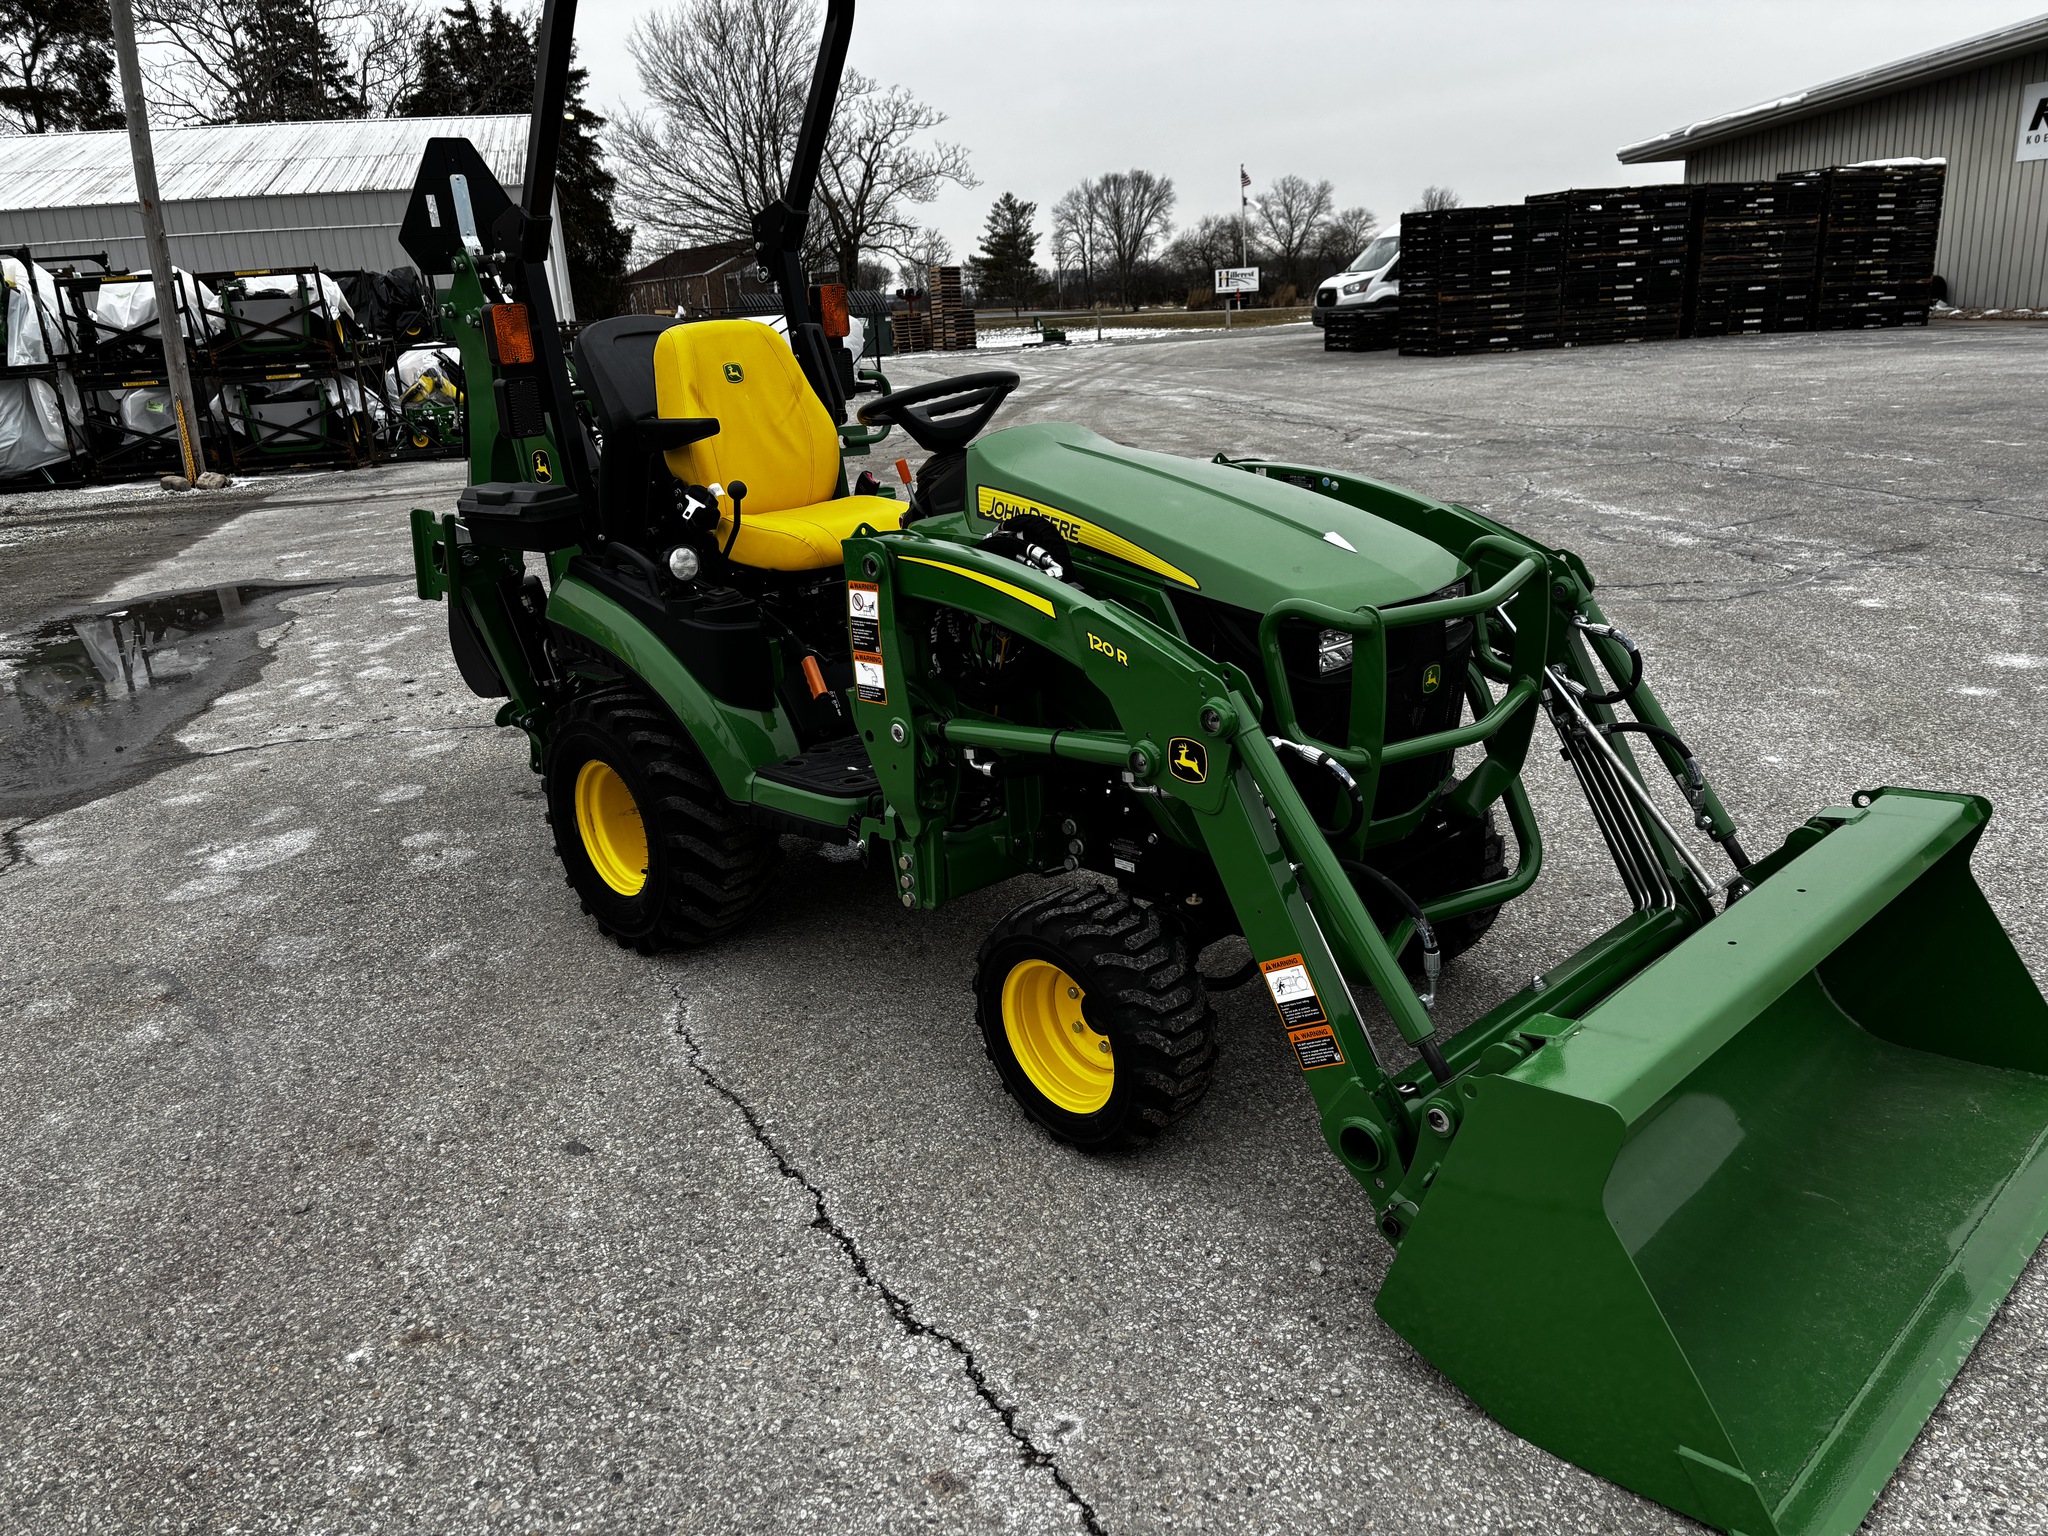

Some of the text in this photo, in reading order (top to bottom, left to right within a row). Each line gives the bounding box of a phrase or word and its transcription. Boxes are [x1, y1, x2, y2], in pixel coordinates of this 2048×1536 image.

[986, 497, 1025, 519] JOHN
[853, 582, 877, 591] WARNING
[859, 654, 882, 664] WARNING
[1271, 958, 1299, 969] WARNING
[1300, 1029, 1329, 1039] WARNING
